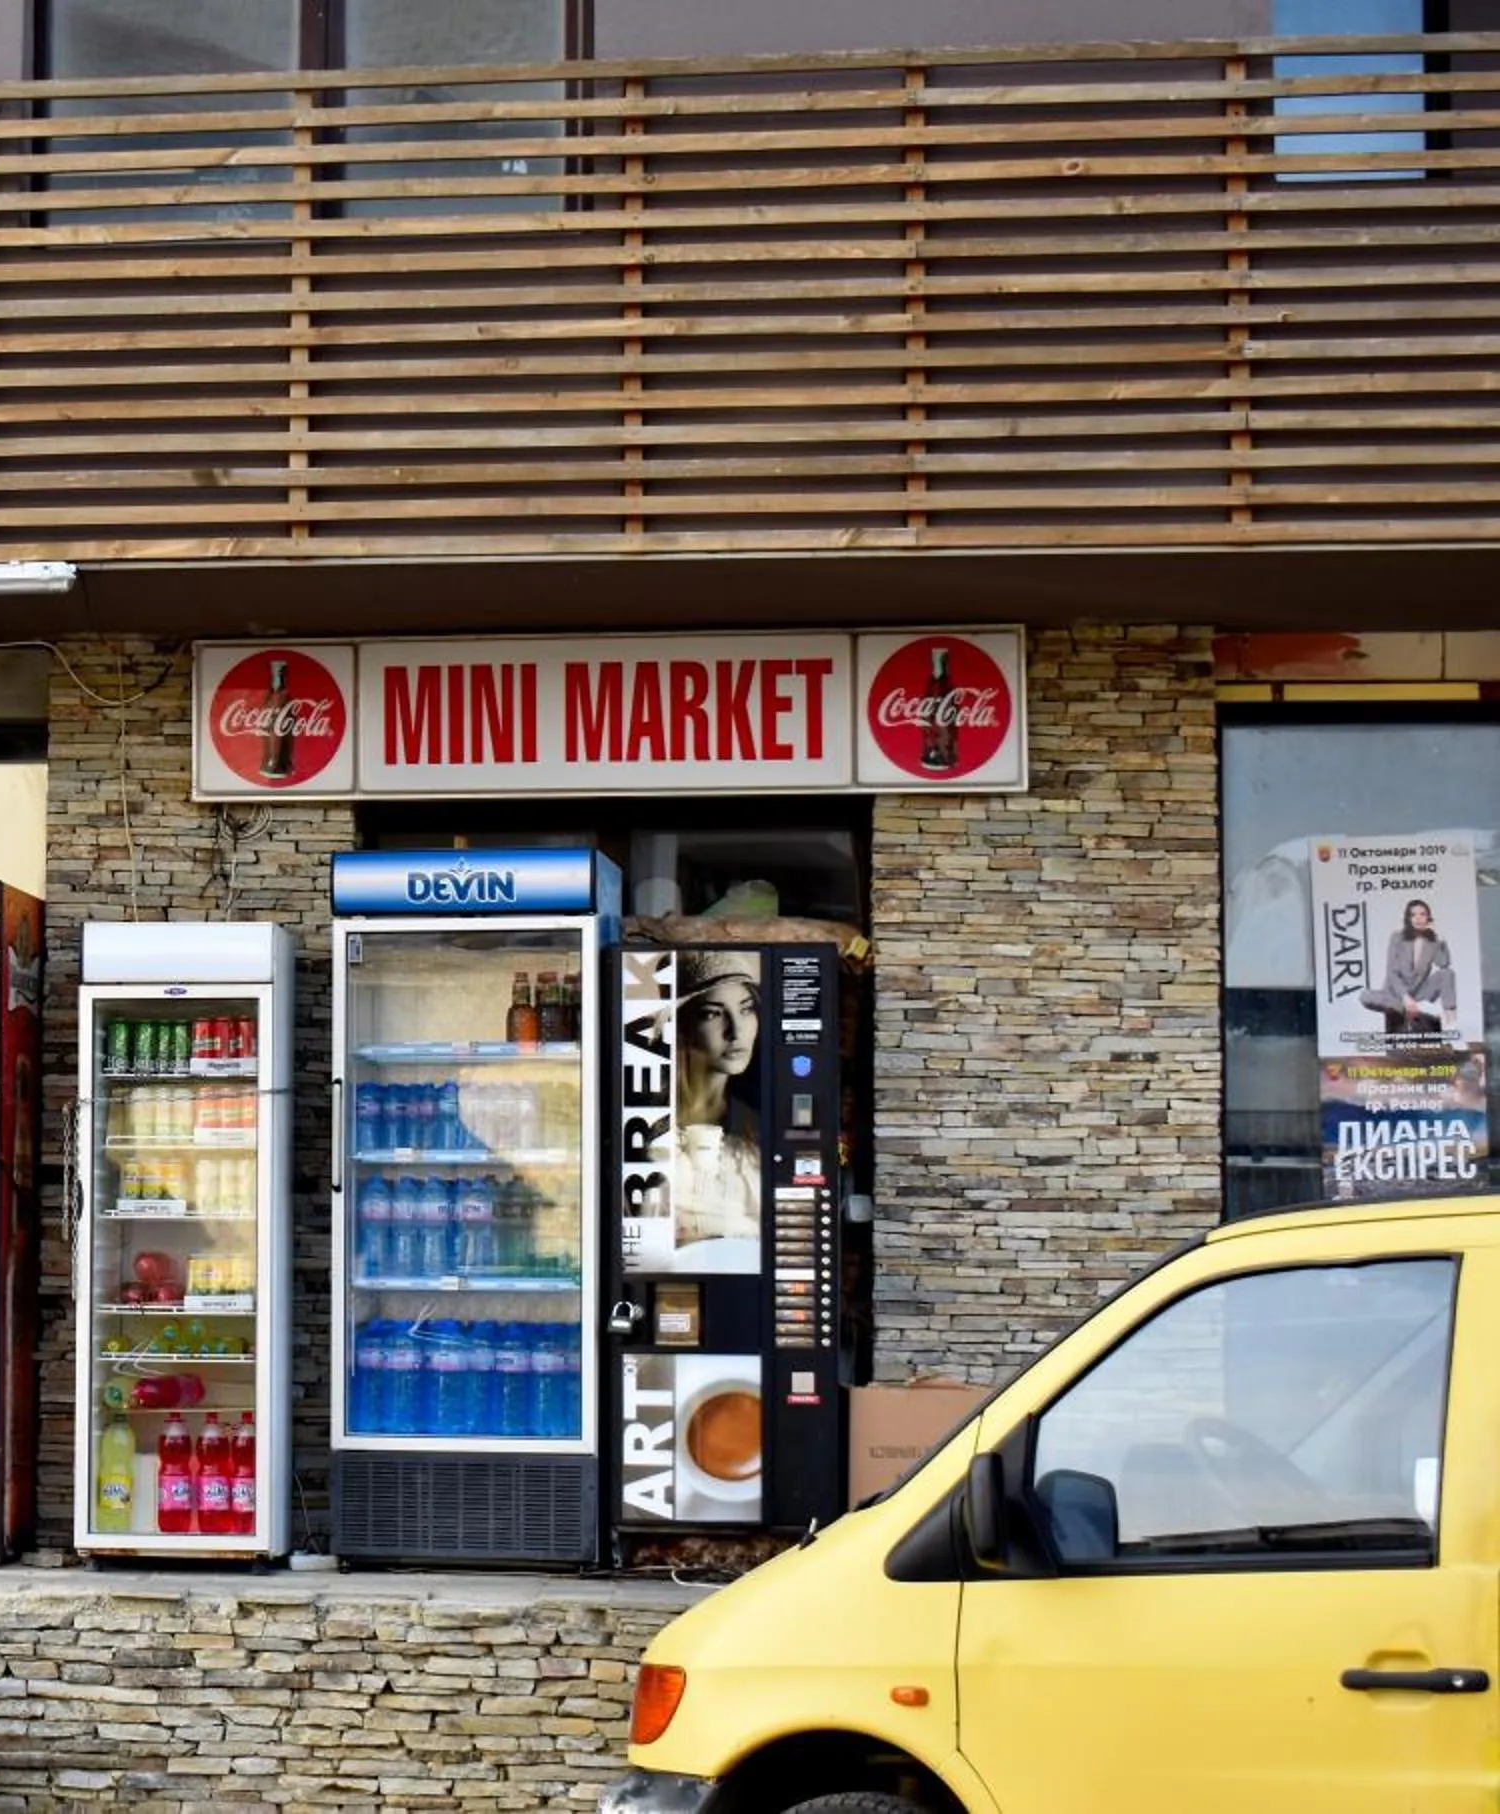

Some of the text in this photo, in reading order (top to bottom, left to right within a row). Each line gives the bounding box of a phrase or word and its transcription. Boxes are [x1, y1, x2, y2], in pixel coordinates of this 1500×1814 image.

[219, 698, 335, 737] Coca-Cola
[383, 658, 833, 766] MINI MARKET
[878, 687, 999, 728] Coca-Cola
[406, 870, 517, 904] DEVIN
[1348, 863, 1438, 878] Празник на
[1356, 879, 1435, 892] гр. Разлог
[623, 951, 672, 1218] BREAK
[1334, 1140, 1477, 1181] ЕКСПРЕС
[622, 1373, 674, 1520] ART
